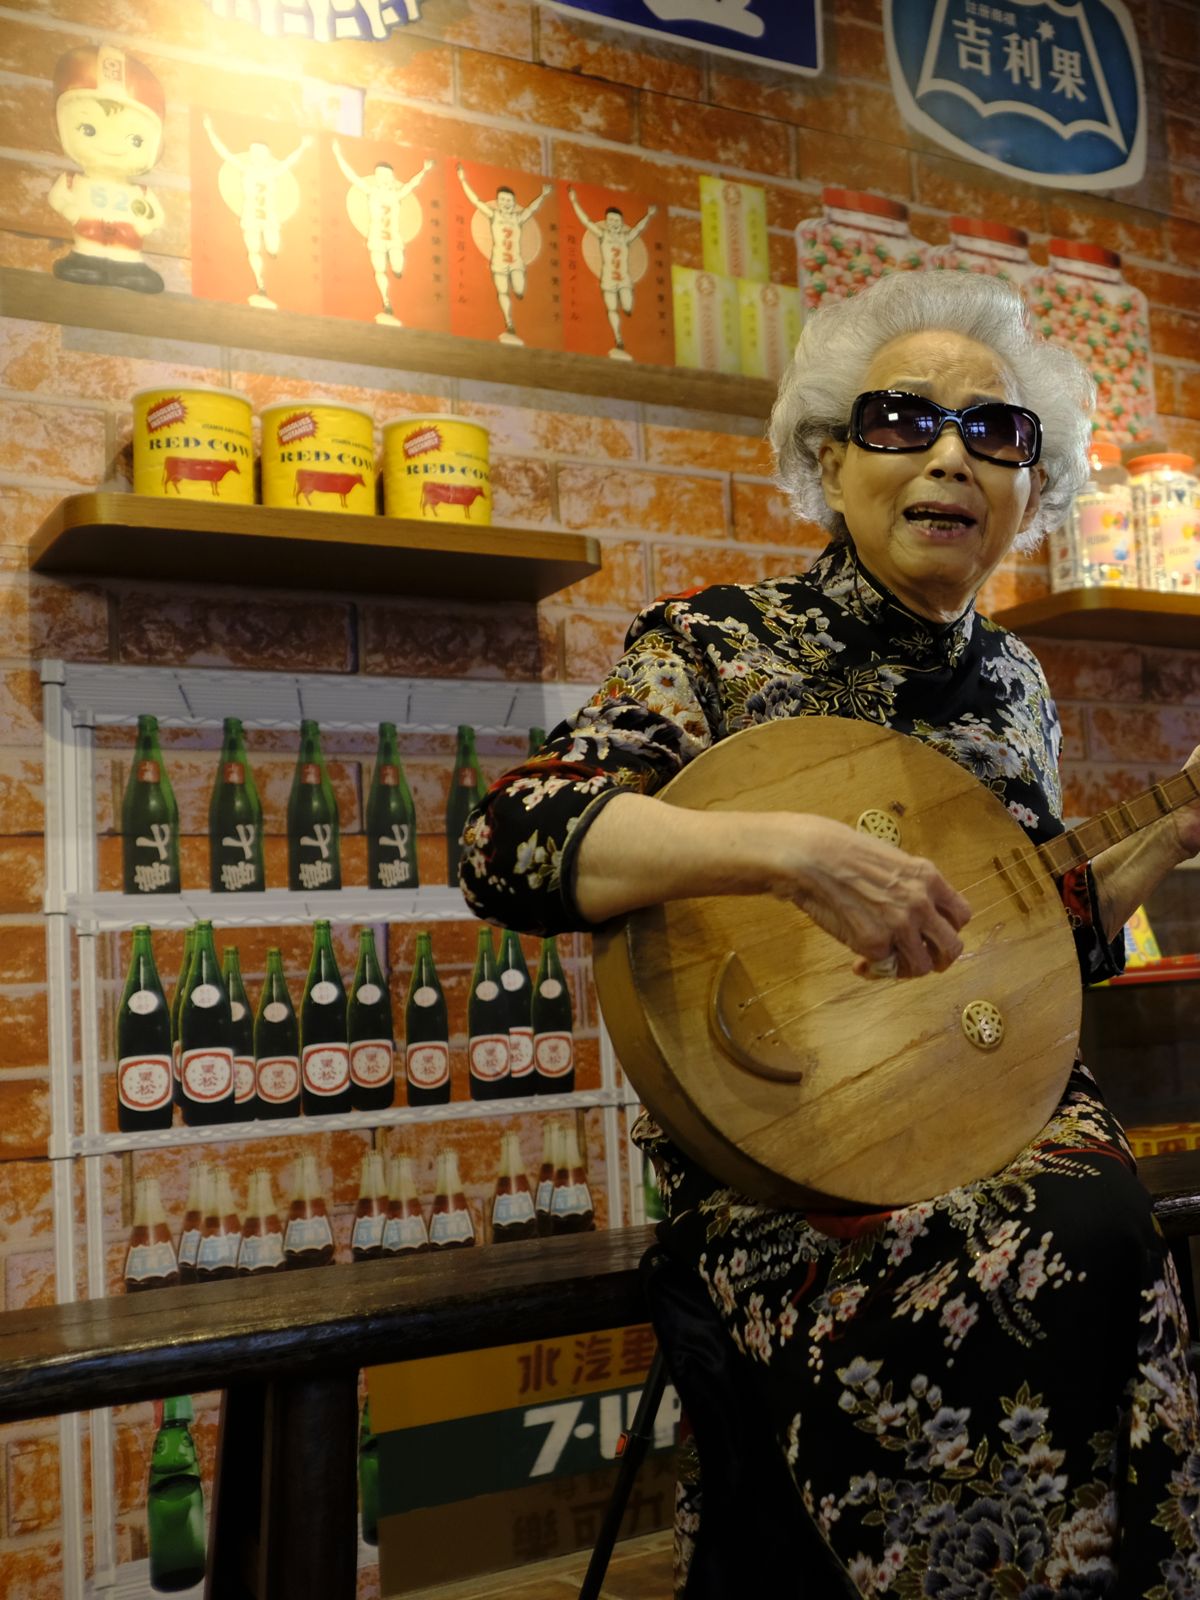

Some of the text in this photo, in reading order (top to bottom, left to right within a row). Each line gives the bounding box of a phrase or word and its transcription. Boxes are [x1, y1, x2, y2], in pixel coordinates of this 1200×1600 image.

[952, 17, 1087, 102] 吉利果
[149, 436, 202, 451] RED
[280, 450, 332, 463] RED
[406, 463, 456, 476] RED
